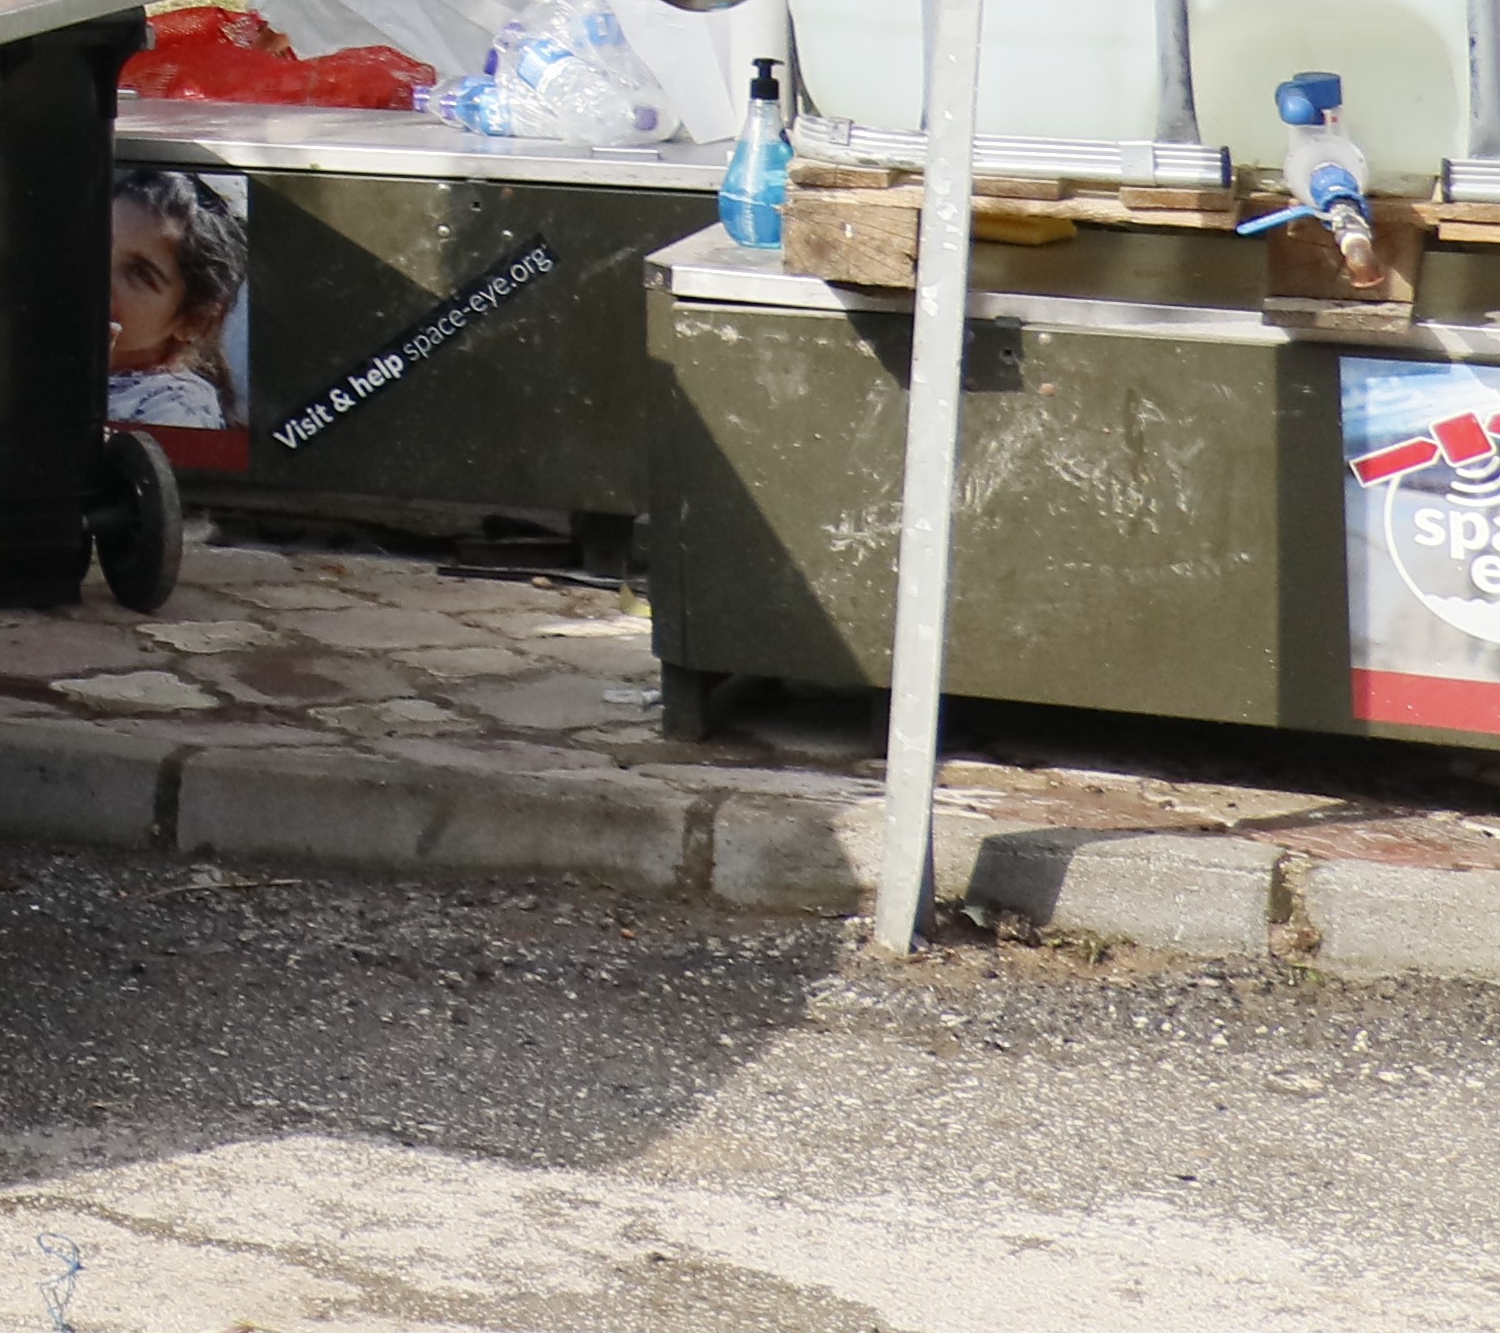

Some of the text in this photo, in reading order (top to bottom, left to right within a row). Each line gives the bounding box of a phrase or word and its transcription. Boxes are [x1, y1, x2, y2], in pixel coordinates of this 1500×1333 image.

[272, 244, 554, 449] Visit & help space-eye.org
